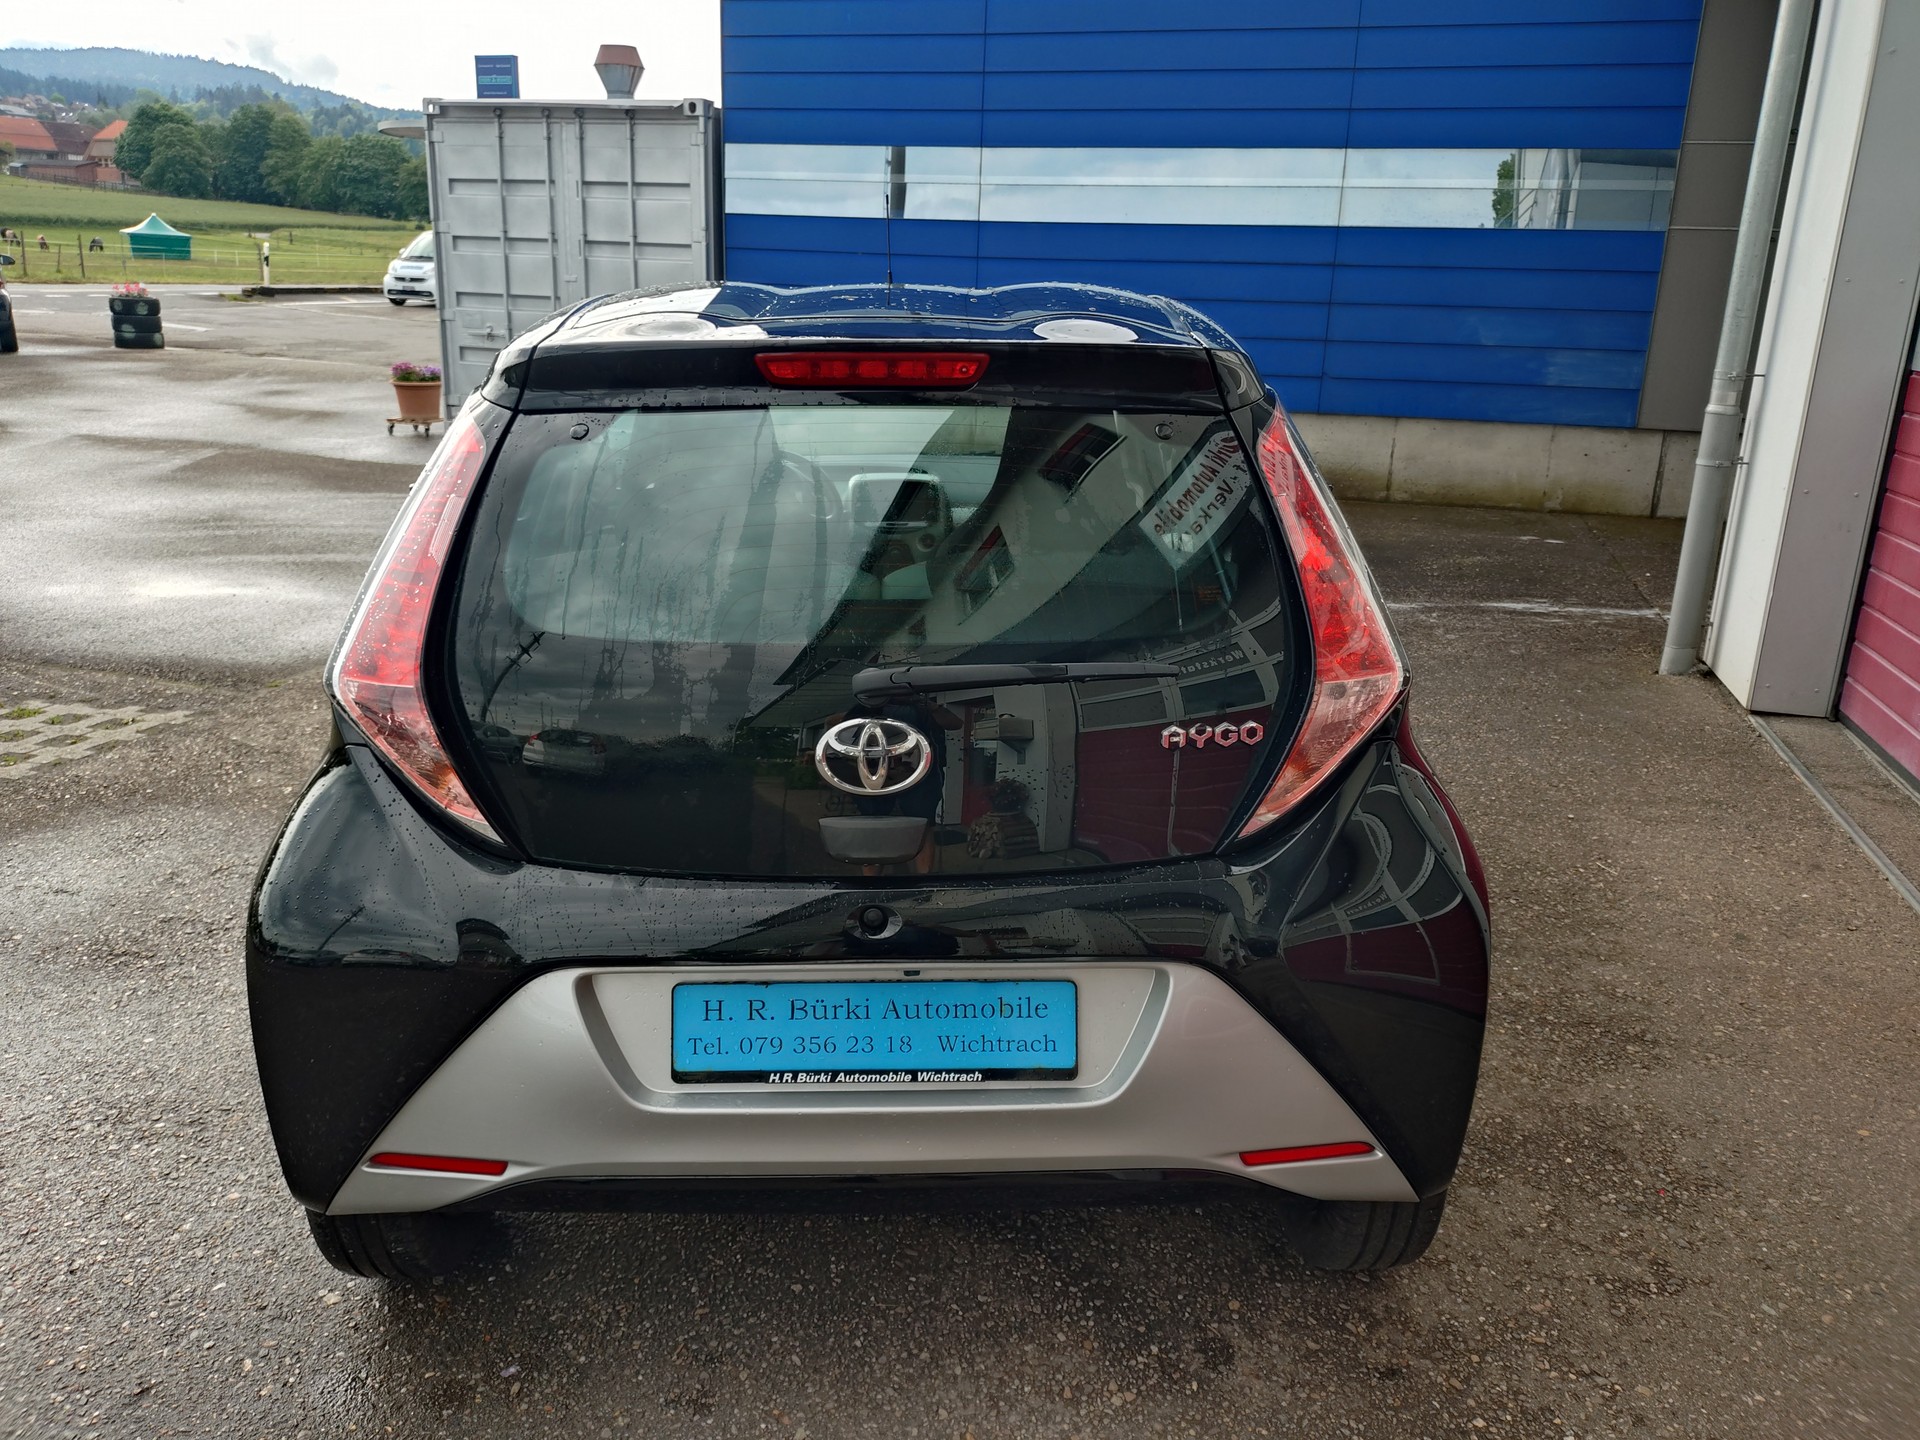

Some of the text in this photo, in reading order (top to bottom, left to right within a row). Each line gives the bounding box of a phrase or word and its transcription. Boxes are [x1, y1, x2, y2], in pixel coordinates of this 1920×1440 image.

[1160, 720, 1264, 749] AYGO
[703, 996, 1049, 1021] H. R. Bürki Automobile
[687, 1034, 1058, 1055] Tel. 079 356 23 18 Wichtrach
[835, 1072, 912, 1083] Automobile
[917, 1071, 982, 1082] Wichtrach
